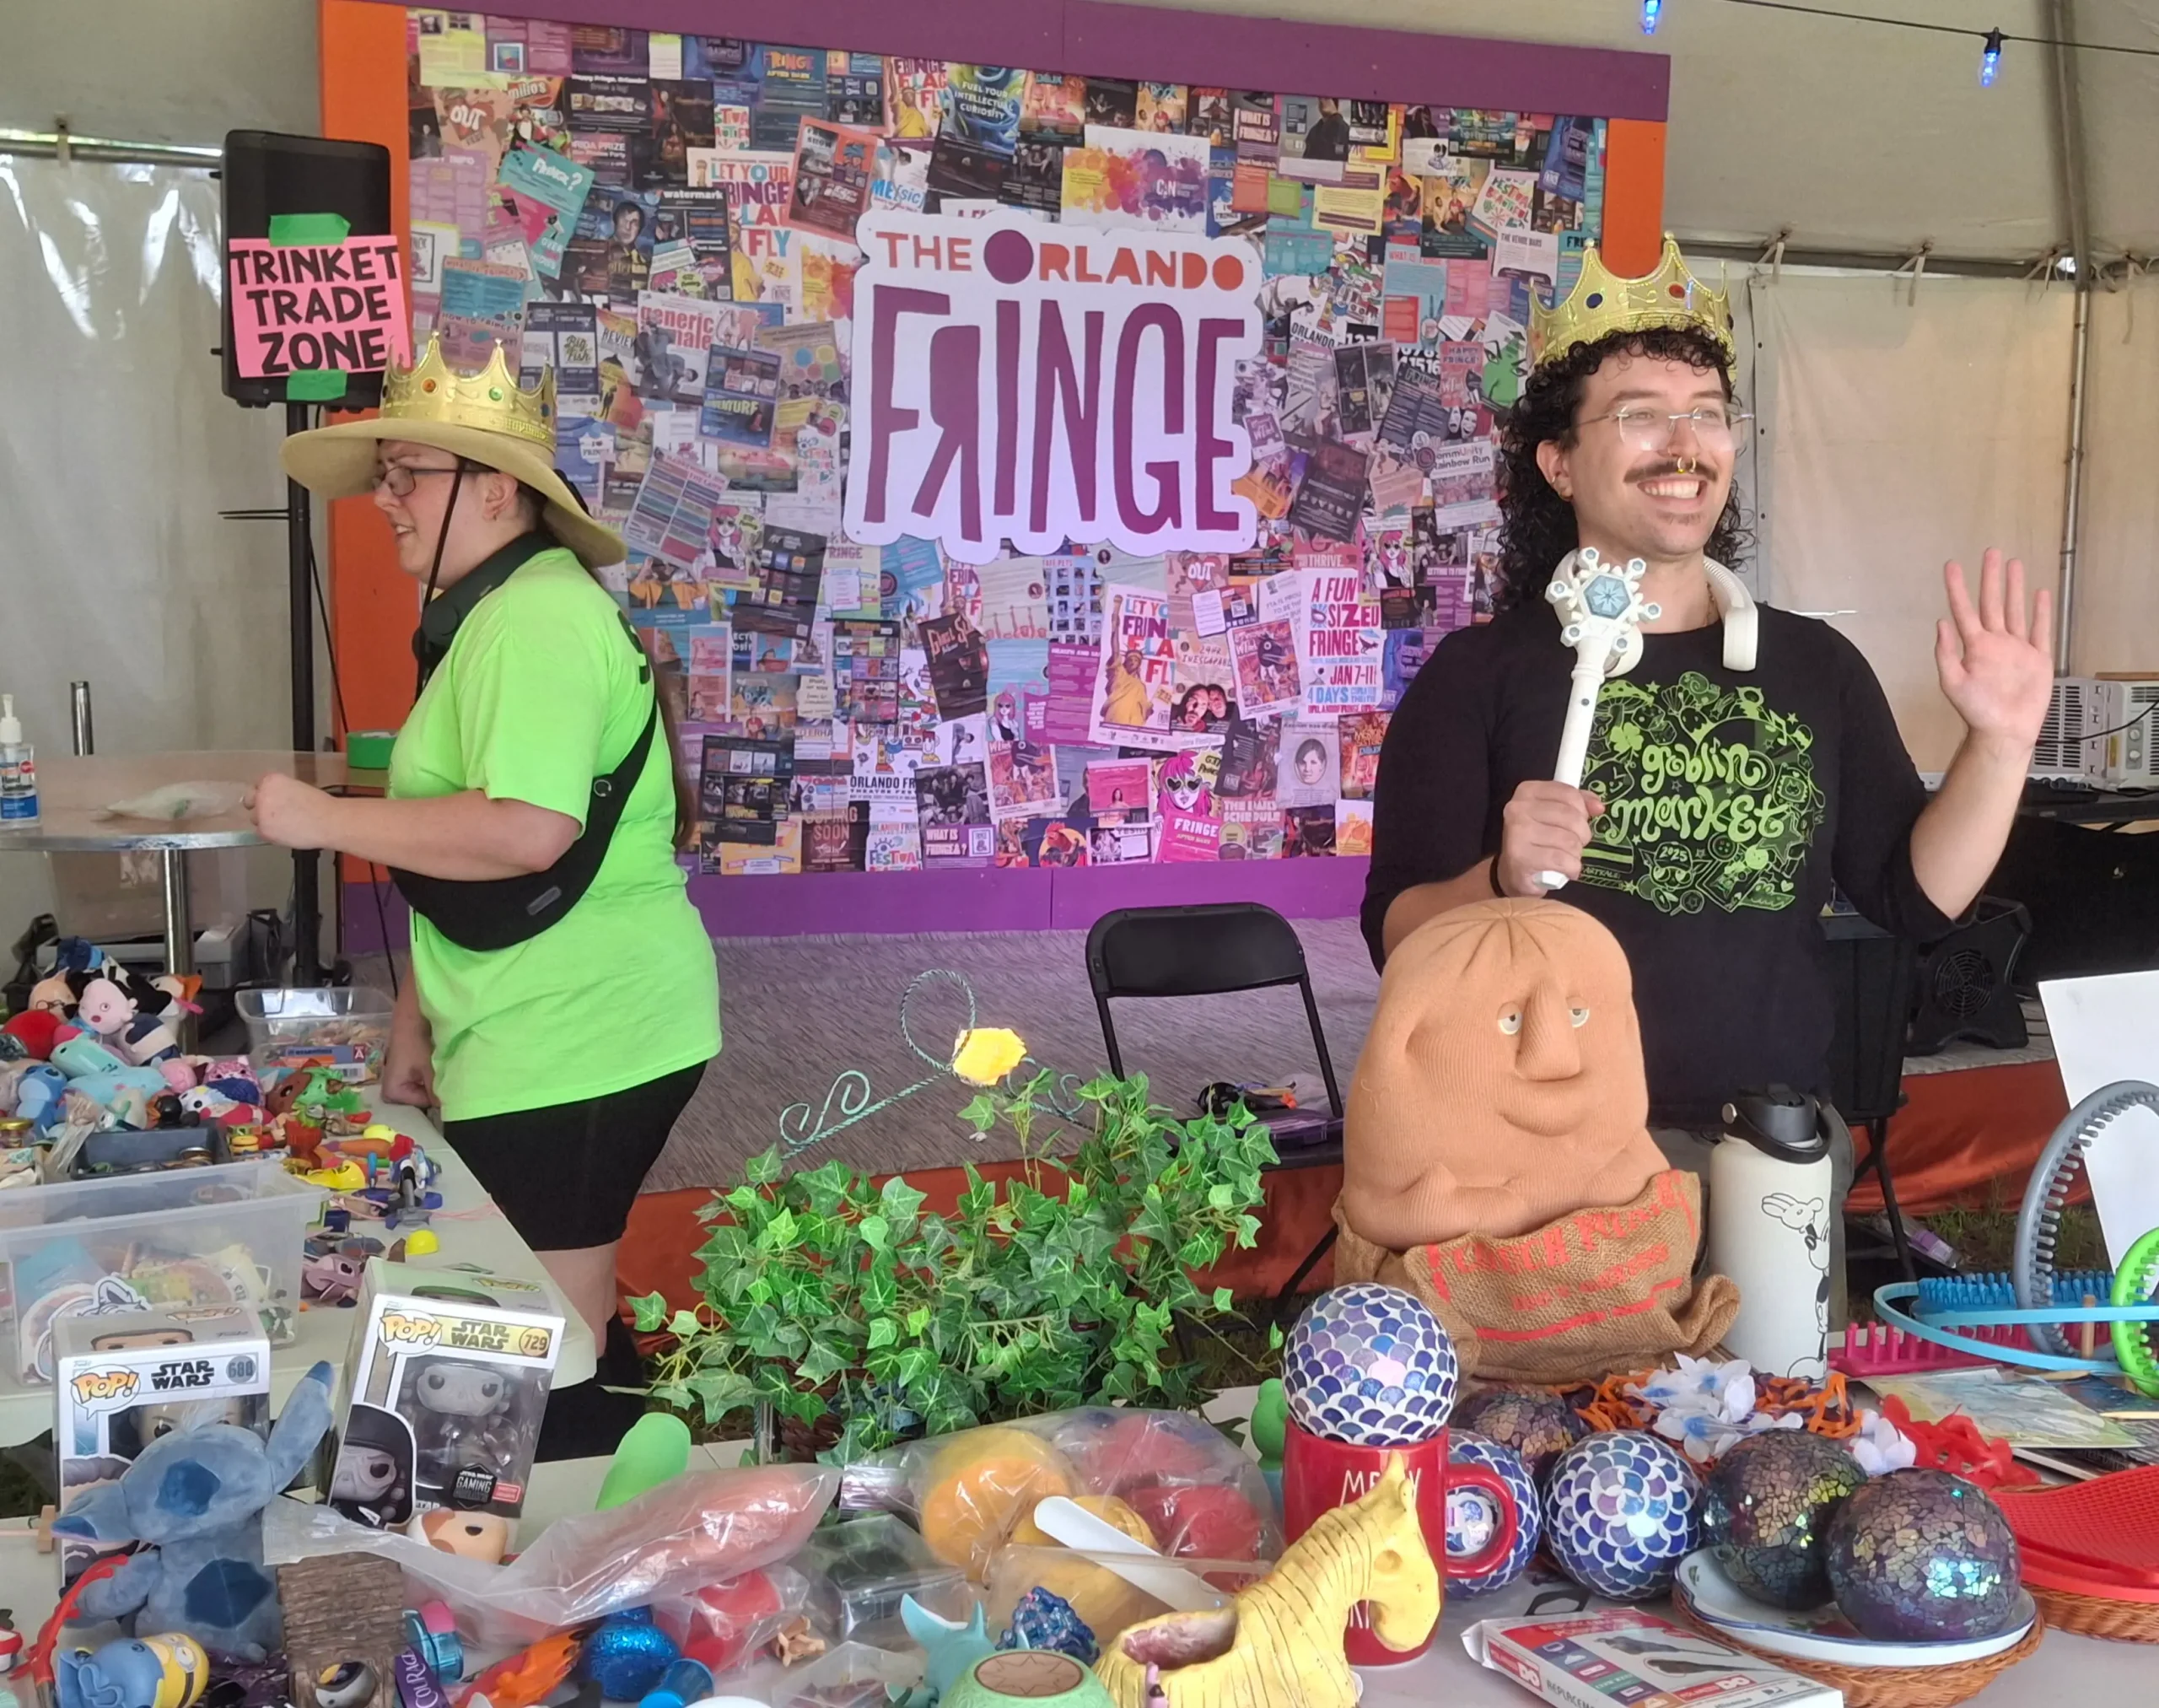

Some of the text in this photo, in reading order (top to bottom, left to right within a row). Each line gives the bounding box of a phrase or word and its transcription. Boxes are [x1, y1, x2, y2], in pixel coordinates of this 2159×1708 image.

[765, 51, 815, 70] FRINGE
[894, 58, 947, 74] FRINGE
[961, 81, 1009, 98] FUEL YOUR
[954, 91, 1014, 110] INTELLECTUAL
[450, 105, 487, 131] OUT
[960, 103, 1005, 120] CURIOSITY
[1240, 110, 1271, 127] WHAT IS
[711, 163, 789, 182] LET YOUR
[664, 190, 724, 200] watermark
[748, 229, 791, 257] FLY
[231, 245, 399, 286] TRINKET
[875, 229, 1244, 292] THE ORLANDO
[246, 285, 392, 327] TRADE
[442, 312, 460, 321] HOW
[640, 305, 715, 334] generic
[564, 334, 588, 353] Big
[1291, 321, 1336, 348] ORLANDO
[258, 328, 387, 375] ZONE
[566, 347, 591, 363] Fish
[1448, 346, 1478, 355] HAPPY
[864, 283, 1245, 543] FRINGE
[1436, 445, 1483, 460] ommUnity
[1473, 455, 1491, 464] Run
[1187, 562, 1215, 581] OUT
[1311, 577, 1358, 603] A FUN
[1125, 598, 1149, 615] LET
[1327, 603, 1380, 628] SIZED
[1309, 629, 1359, 656] FRINGE
[1330, 665, 1353, 685] JAN
[1307, 687, 1313, 703] 4
[1316, 687, 1349, 703] DAYS
[1641, 737, 1765, 795] goblin
[850, 776, 900, 789] ORLANDO
[902, 777, 917, 789] FR
[1604, 785, 1791, 845] market
[813, 824, 850, 840] SOON
[926, 828, 958, 841] WHAT IS
[1173, 818, 1219, 837] FRINGE
[869, 849, 923, 865] FESTIVAL
[1659, 846, 1688, 862] 2025
[380, 1314, 443, 1346] POP!
[452, 1321, 510, 1338] STAR
[451, 1332, 509, 1350] WARS
[525, 1334, 548, 1350] 729
[151, 1360, 214, 1377] STAR
[70, 1371, 139, 1404] POP!
[151, 1373, 214, 1390] WARS
[456, 1477, 493, 1493] GAMING
[1339, 1468, 1421, 1507] MEY
